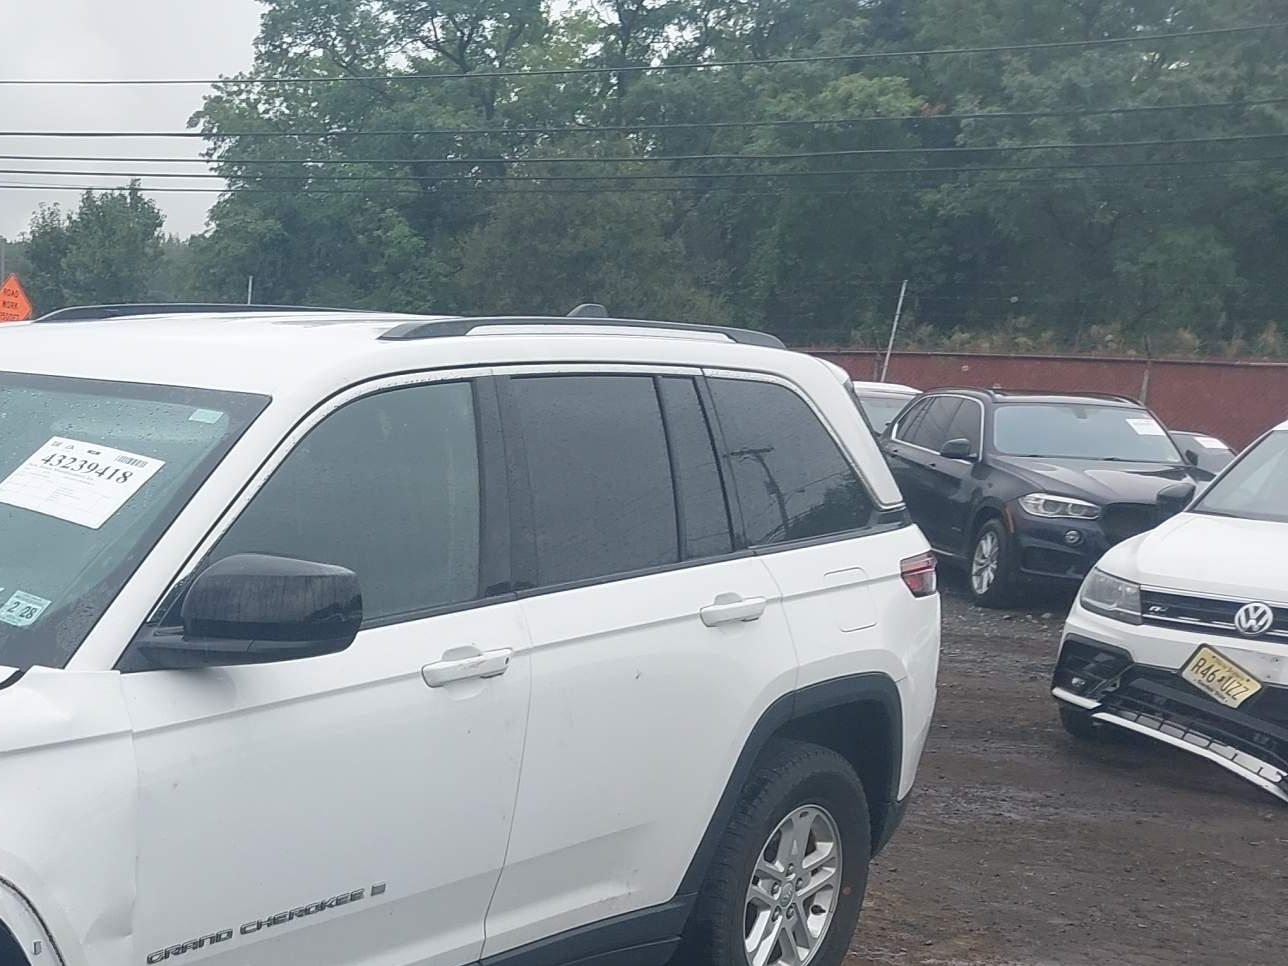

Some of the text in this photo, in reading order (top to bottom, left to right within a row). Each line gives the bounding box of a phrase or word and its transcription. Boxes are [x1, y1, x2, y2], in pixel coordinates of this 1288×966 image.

[3, 288, 20, 298] ROAD
[2, 300, 18, 310] WORK
[41, 453, 133, 484] 43239418
[19, 606, 38, 620] 28
[146, 888, 365, 965] GRAND CHEROKEE
